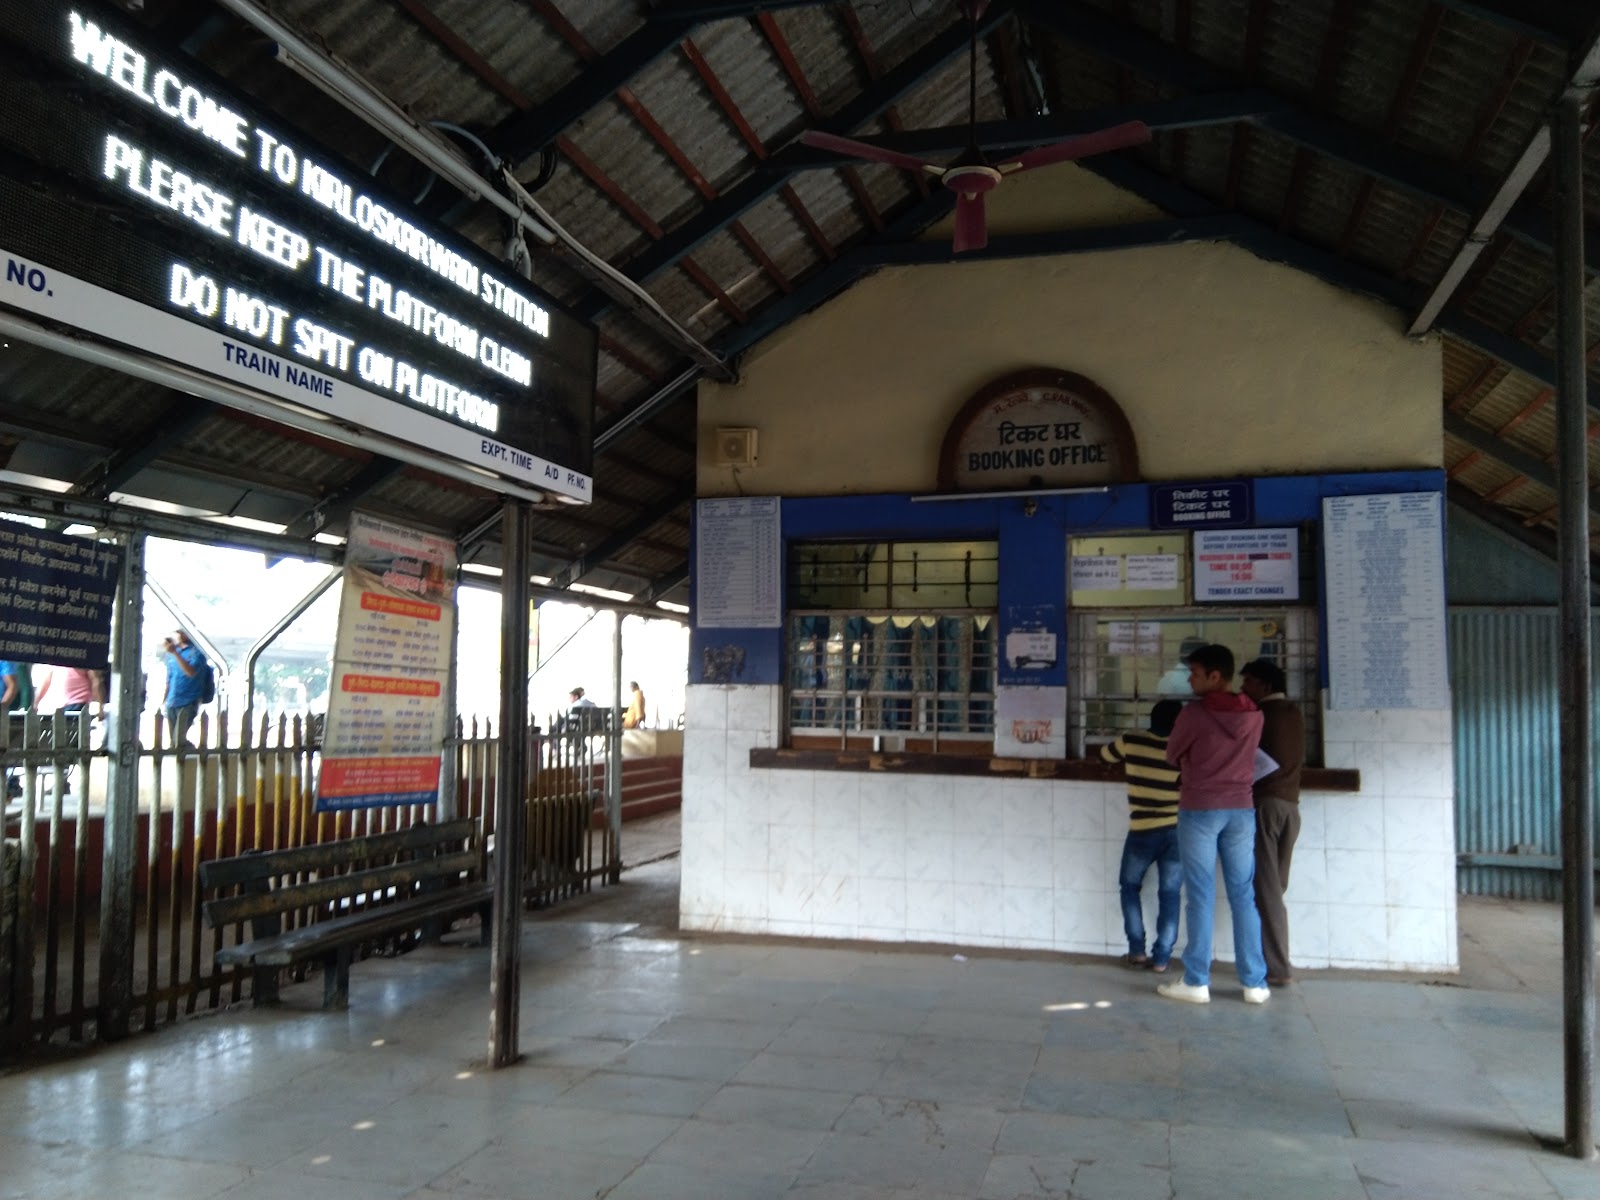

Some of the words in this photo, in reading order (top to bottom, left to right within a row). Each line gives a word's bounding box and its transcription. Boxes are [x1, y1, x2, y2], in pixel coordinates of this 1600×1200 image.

[68, 10, 249, 158] WELCOME
[256, 128, 297, 184] TO
[302, 157, 480, 294] KIRLOSKARWADI
[482, 278, 550, 338] STATION
[103, 134, 233, 238] PLEASE
[237, 206, 310, 270] KEEP
[316, 245, 365, 303] THE
[368, 276, 478, 359] PLATFORM
[480, 336, 531, 387] CLEAN
[6, 259, 54, 298] NO.
[169, 264, 219, 317] DO
[224, 291, 290, 346] NOT
[294, 319, 355, 372] SPIT
[359, 347, 393, 390] ON
[395, 367, 499, 432] PLATFORM
[223, 342, 280, 379] TRAIN
[285, 364, 333, 399] NAME
[998, 421, 1049, 446] टिकट
[1054, 422, 1081, 441] घर
[481, 439, 508, 462] EXPT.
[510, 451, 532, 470] TIME
[968, 450, 1045, 471] BOOKING
[1049, 443, 1107, 465] OFFICE
[544, 465, 559, 480] A/D
[1212, 489, 1230, 498] घर
[1172, 500, 1207, 512] टिकट
[1211, 500, 1230, 509] घर
[1173, 511, 1206, 521] BOOKING
[1207, 509, 1231, 519] OFFICE
[1209, 563, 1227, 571] TIME
[1233, 587, 1253, 595] EXACT
[1254, 586, 1284, 594] CHANGES
[17, 623, 38, 636] FROM
[38, 625, 61, 639] TICKET
[40, 644, 55, 656] THIS
